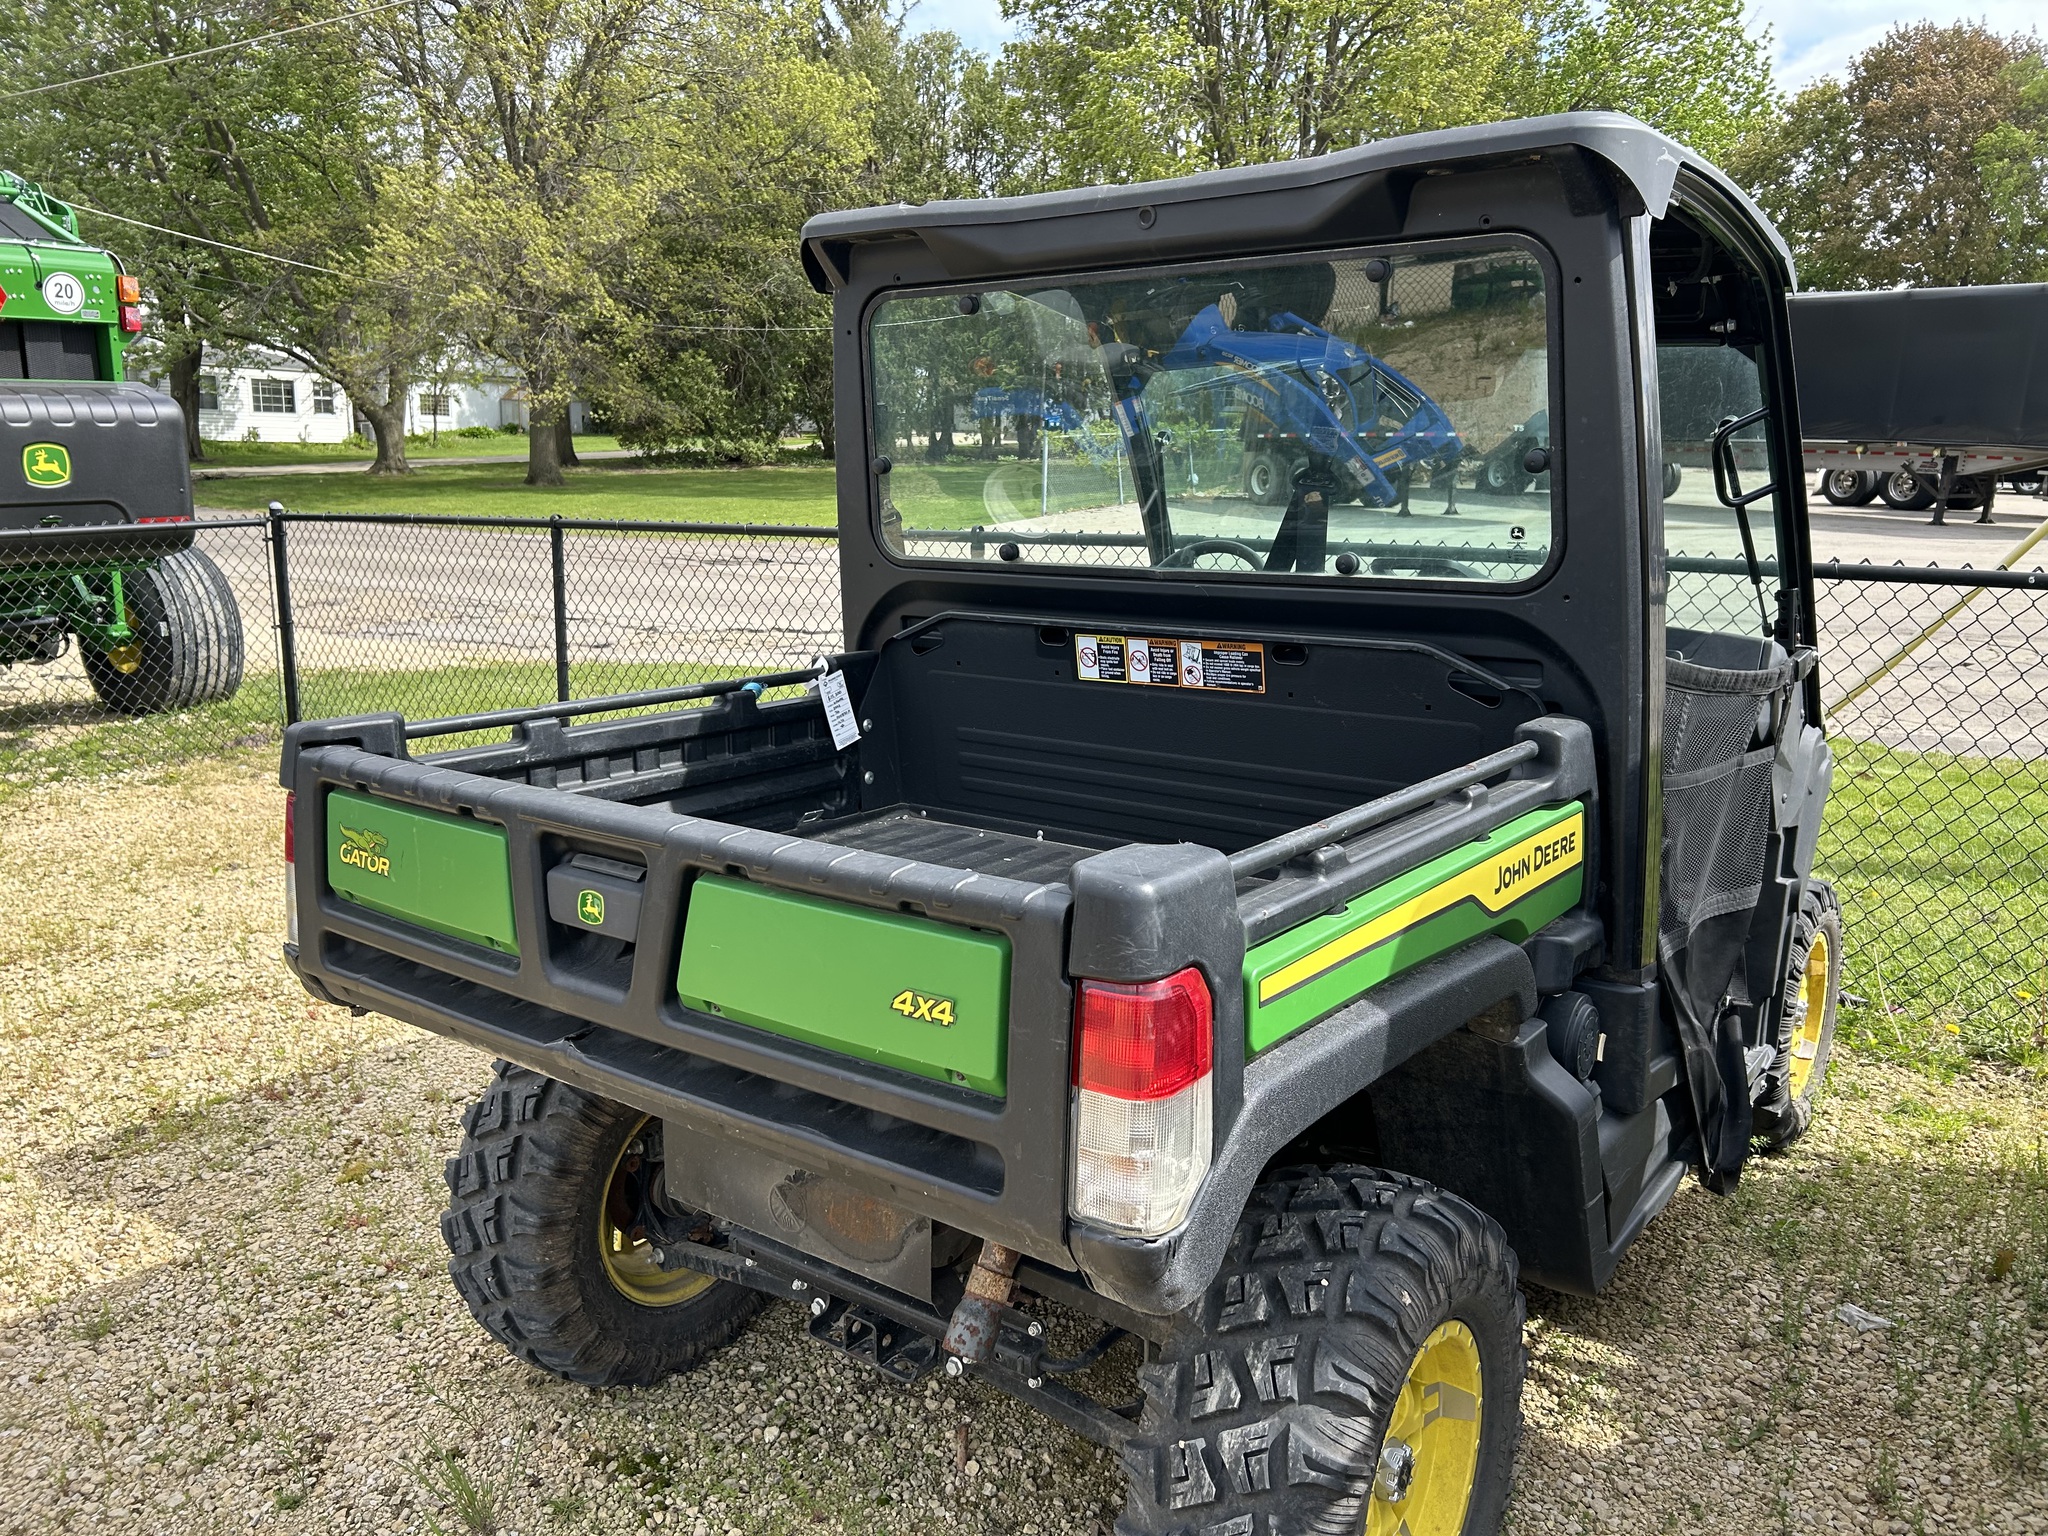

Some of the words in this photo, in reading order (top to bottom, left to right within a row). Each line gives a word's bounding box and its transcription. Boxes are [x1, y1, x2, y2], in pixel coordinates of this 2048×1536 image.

[54, 283, 73, 299] 20
[1154, 639, 1177, 647] WARNING
[339, 843, 390, 877] GATOR
[1494, 855, 1531, 895] JOHN
[1533, 831, 1576, 872] DEERE
